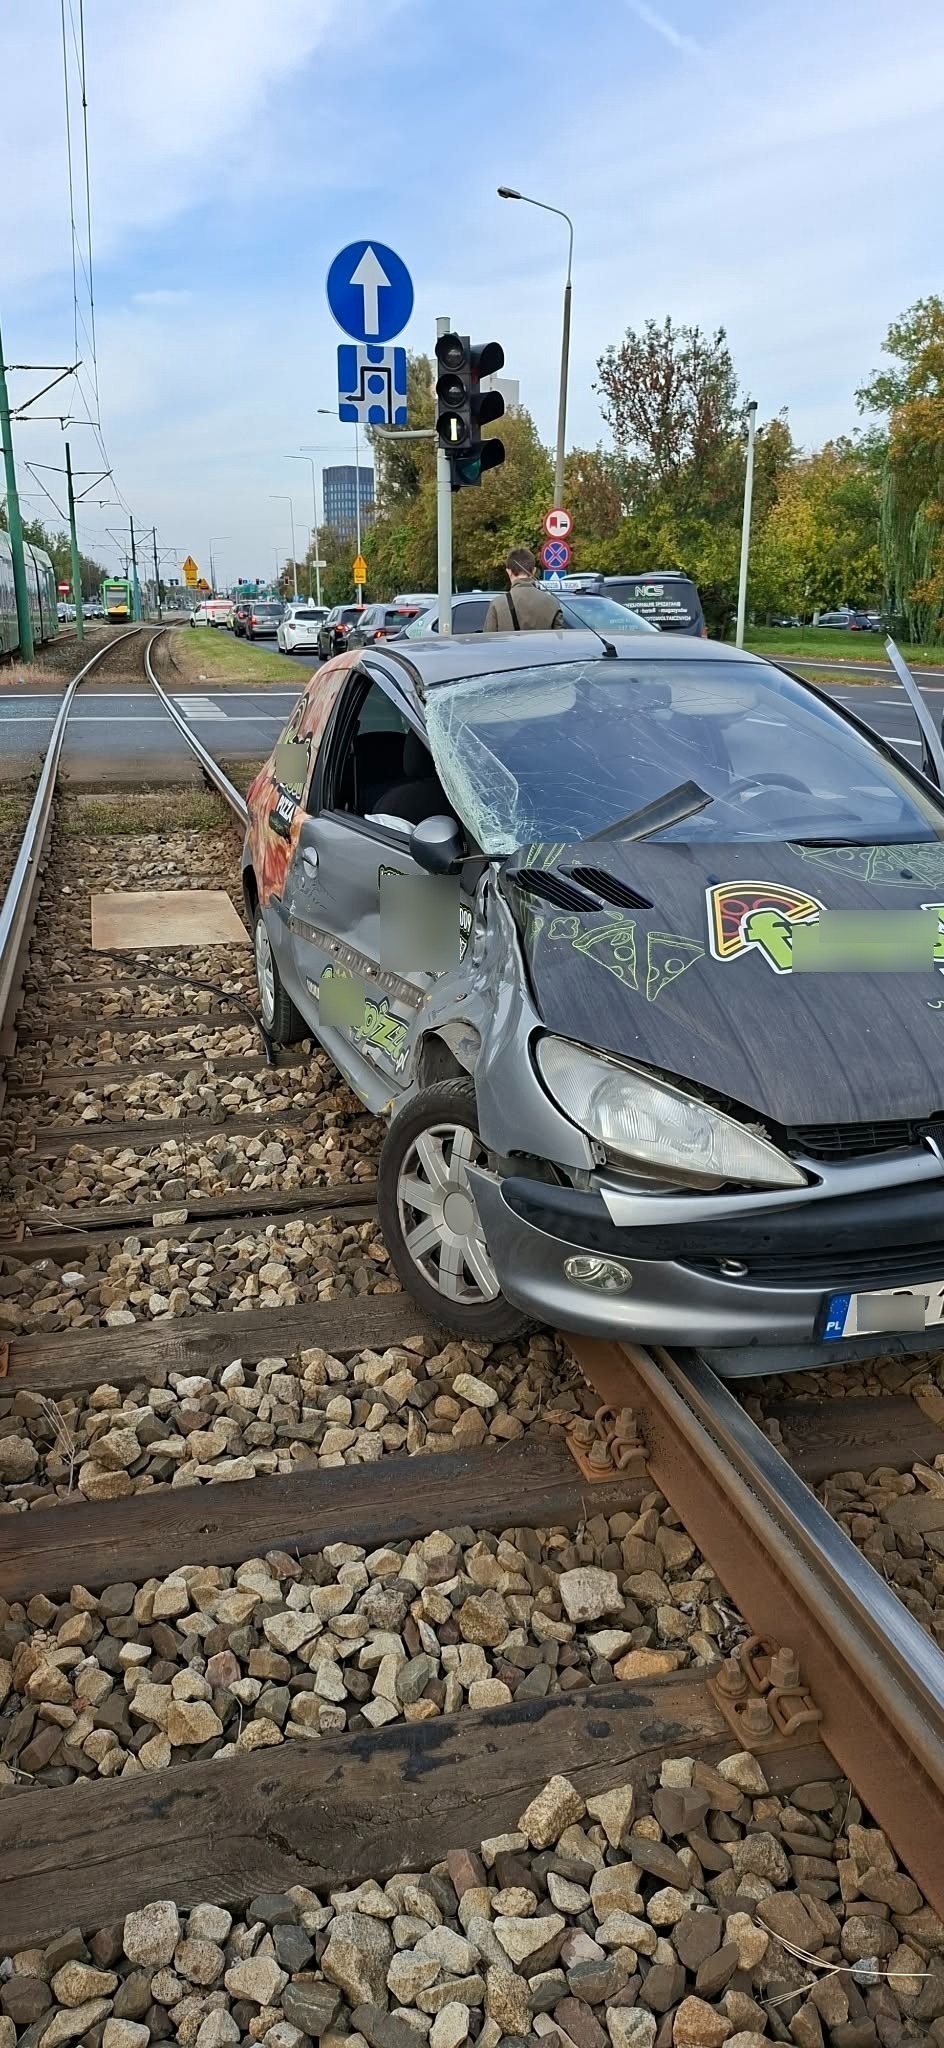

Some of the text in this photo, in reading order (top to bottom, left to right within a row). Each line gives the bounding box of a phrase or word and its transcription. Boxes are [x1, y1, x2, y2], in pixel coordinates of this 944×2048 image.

[635, 585, 664, 597] NCS
[276, 794, 296, 823] PIZZA
[825, 1321, 841, 1332] PL
